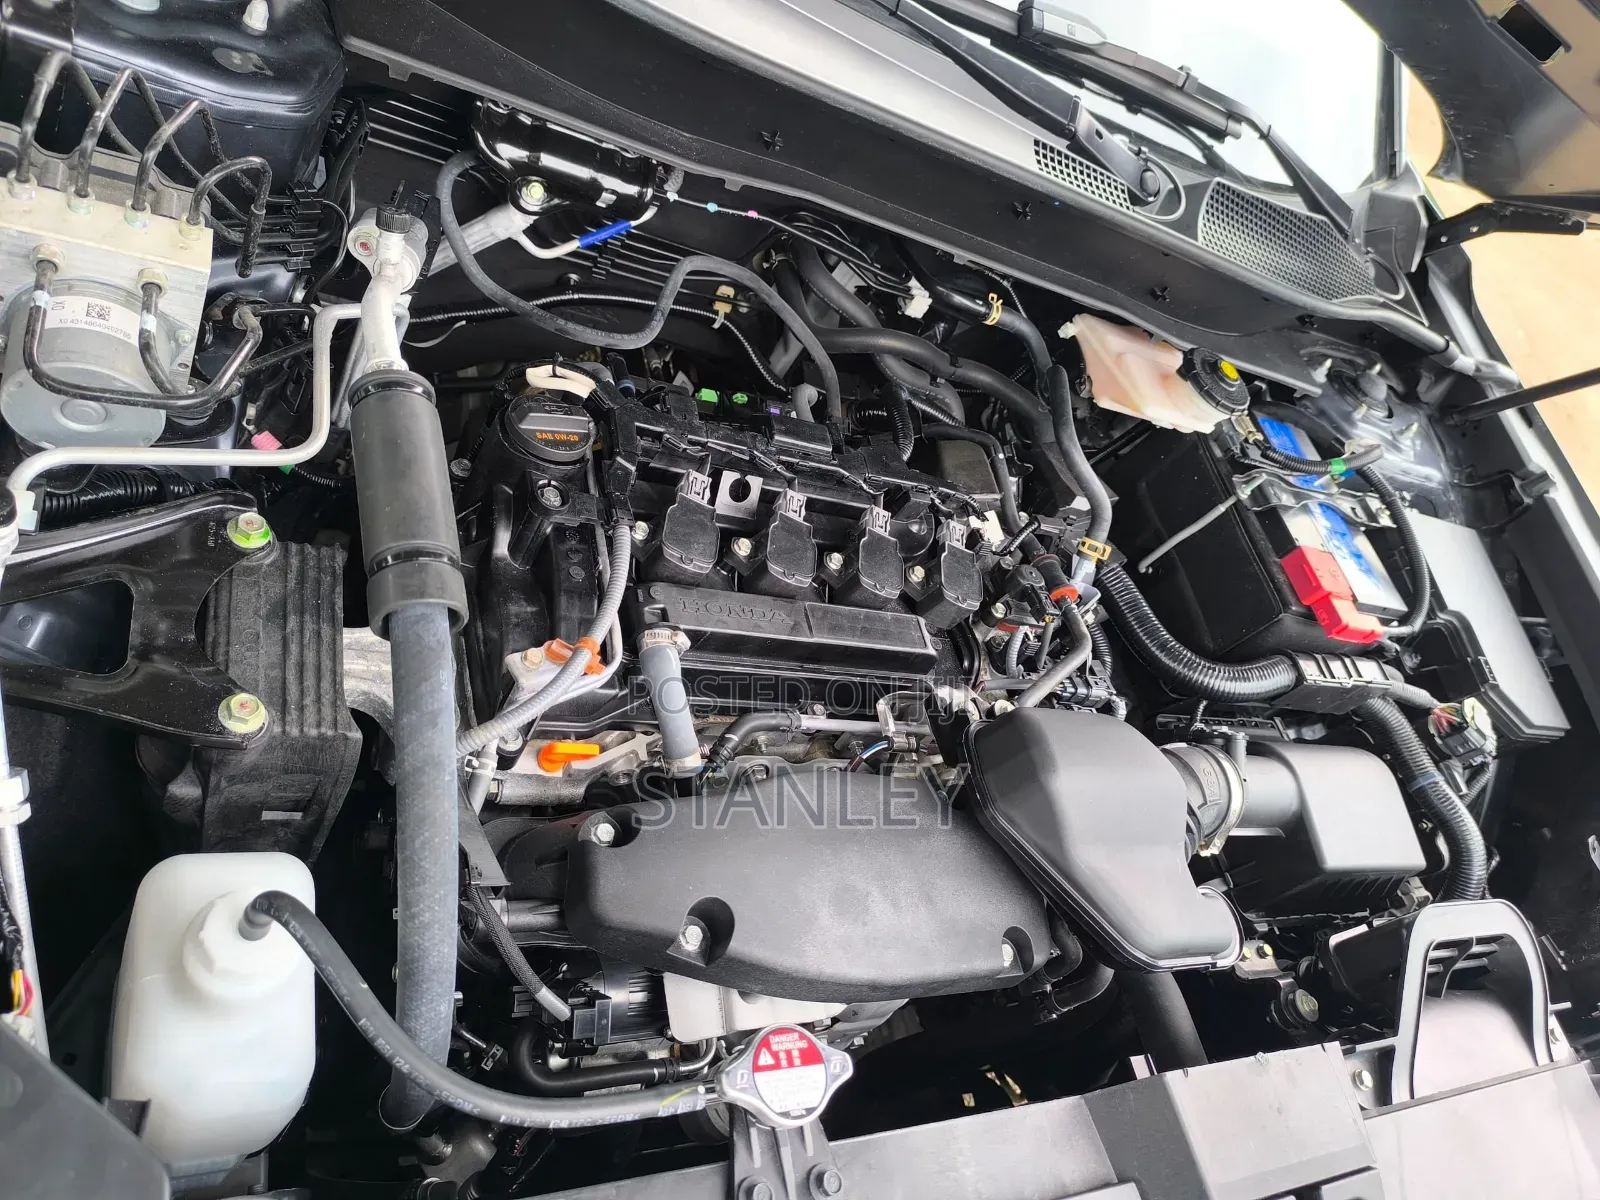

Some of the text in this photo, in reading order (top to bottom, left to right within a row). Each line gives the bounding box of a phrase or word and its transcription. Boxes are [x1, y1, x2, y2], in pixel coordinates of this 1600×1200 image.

[535, 432, 579, 442] SAE 0W-20
[680, 598, 794, 624] HONDA
[769, 1033, 800, 1043] DANGER
[770, 1040, 808, 1052] WARNUNG
